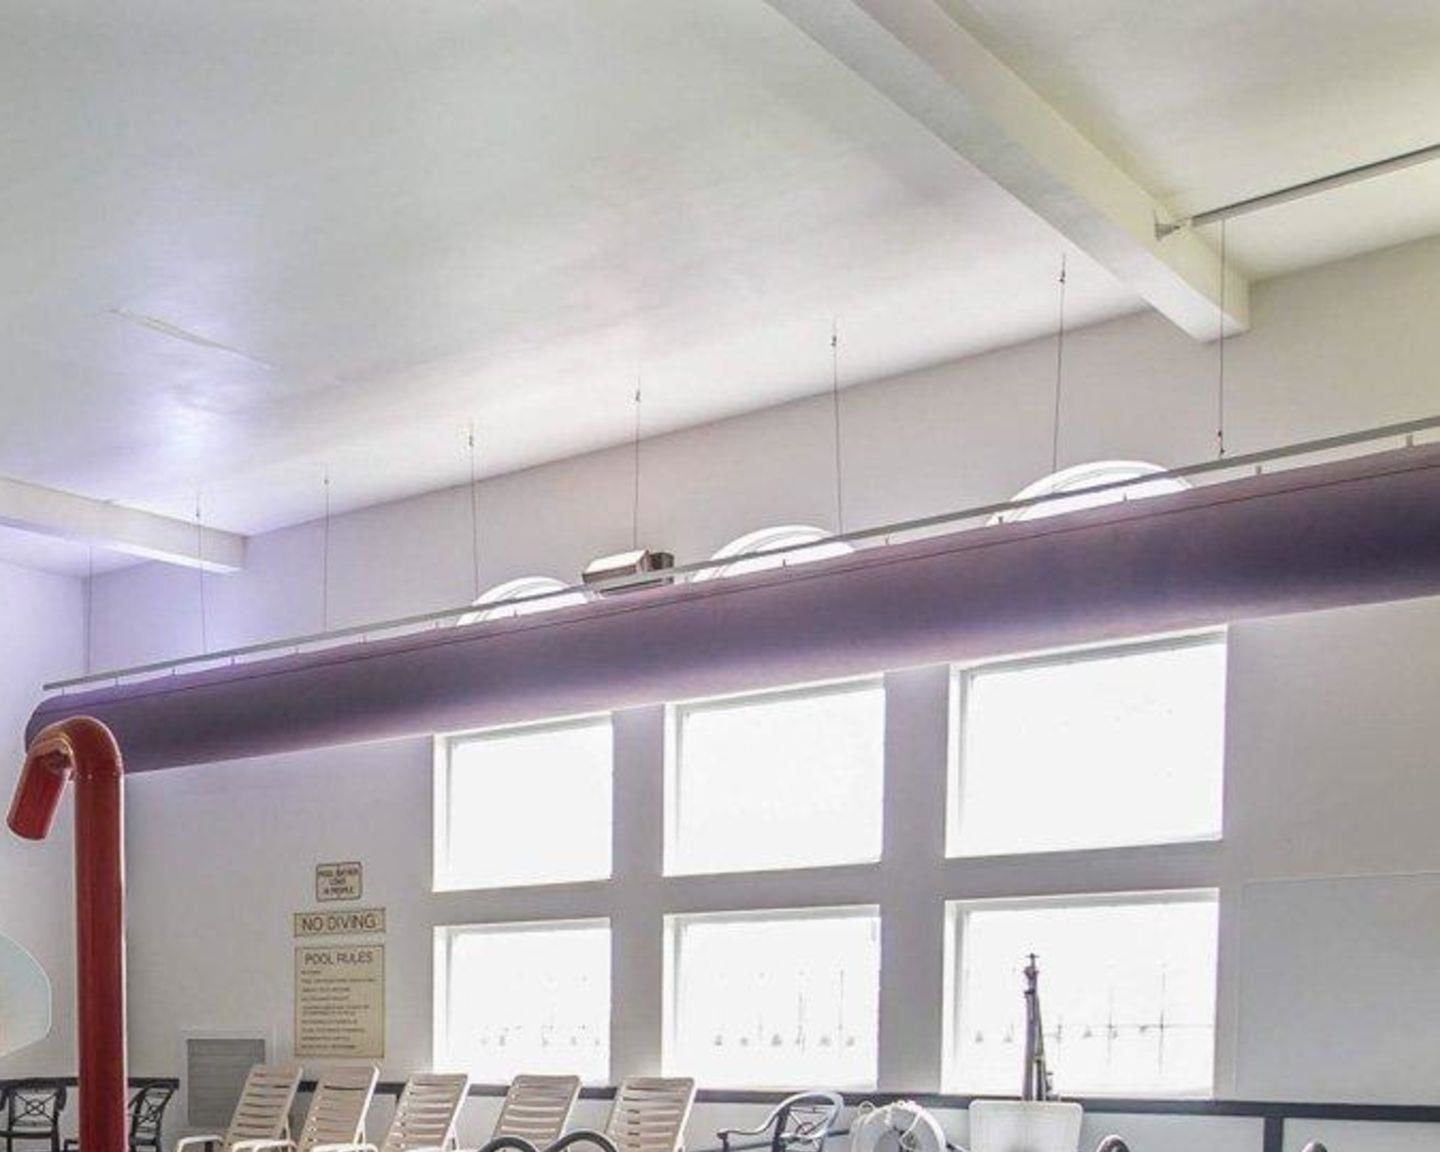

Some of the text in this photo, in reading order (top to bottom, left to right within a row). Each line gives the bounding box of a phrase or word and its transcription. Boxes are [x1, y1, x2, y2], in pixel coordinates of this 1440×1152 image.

[302, 913, 377, 931] NO DIVING
[304, 950, 373, 966] POOL RULES
